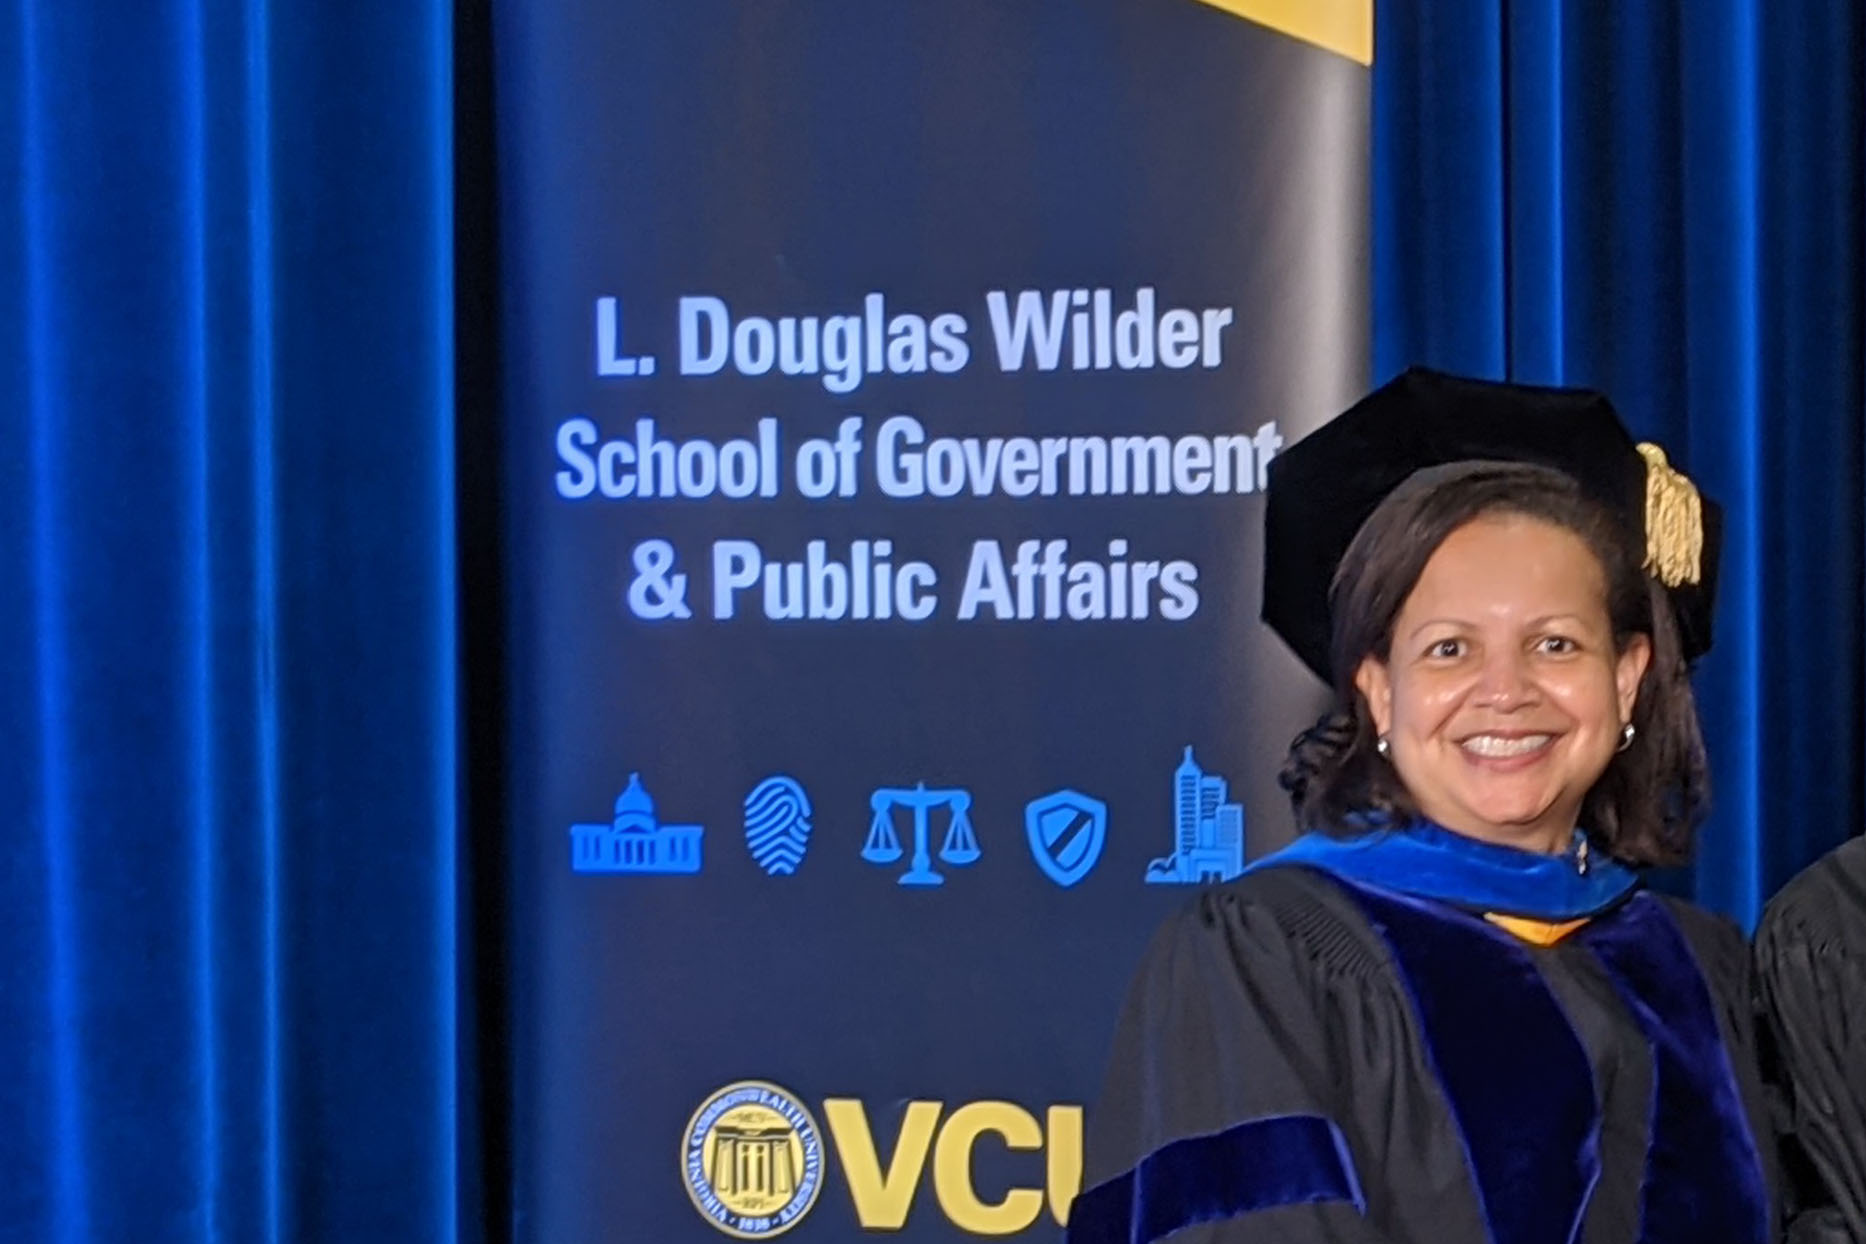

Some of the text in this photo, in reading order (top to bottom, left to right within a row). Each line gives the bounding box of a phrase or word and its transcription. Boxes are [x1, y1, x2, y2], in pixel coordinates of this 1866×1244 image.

[597, 287, 1233, 393] L. Douglas Wilder
[557, 416, 1283, 498] School of Government
[628, 539, 1199, 620] & Public Affairs
